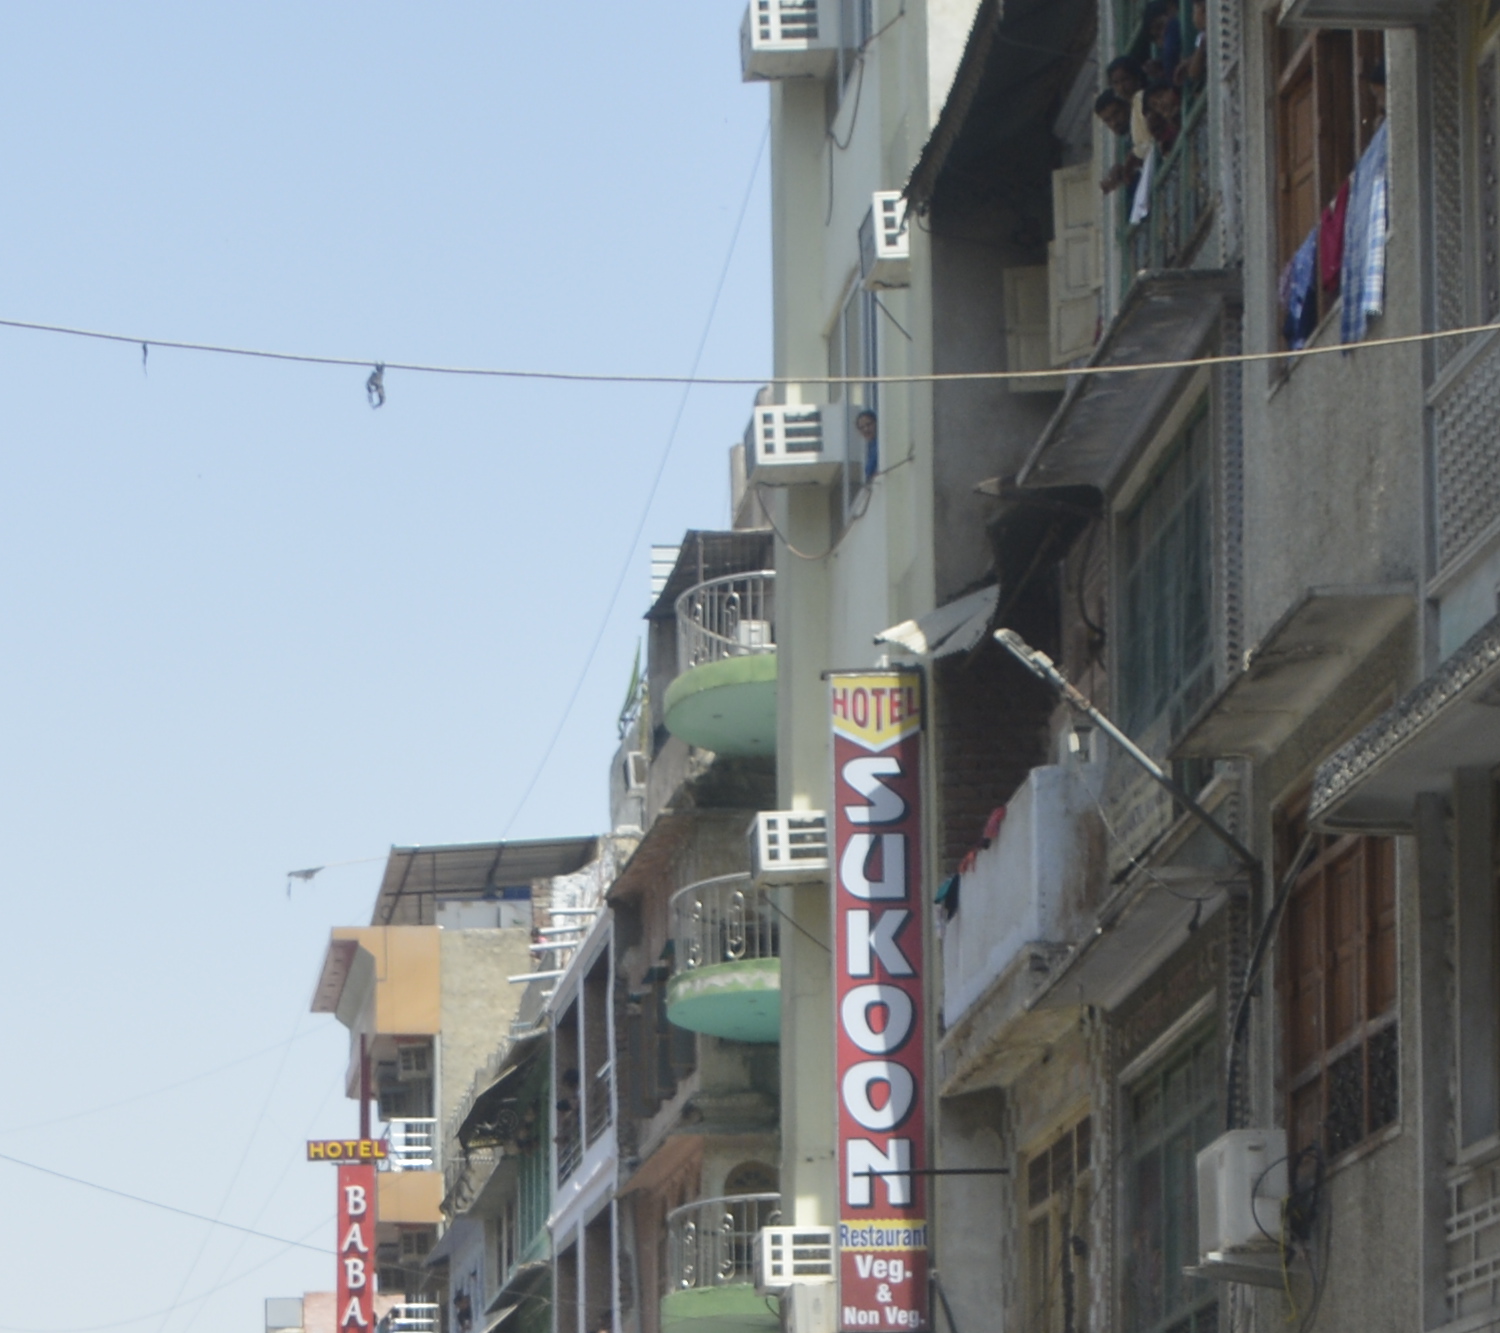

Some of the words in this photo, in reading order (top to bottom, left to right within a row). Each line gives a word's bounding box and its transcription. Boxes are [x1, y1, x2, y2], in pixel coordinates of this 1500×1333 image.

[834, 687, 920, 731] HOTEL
[840, 757, 914, 1206] SUKOON
[308, 1140, 387, 1159] HOTEL
[840, 1224, 928, 1248] Restaurant
[341, 1184, 369, 1328] BABA
[854, 1255, 913, 1282] Veg.
[876, 1284, 892, 1302] &
[843, 1307, 880, 1324] Non
[884, 1307, 926, 1327] Veg.
